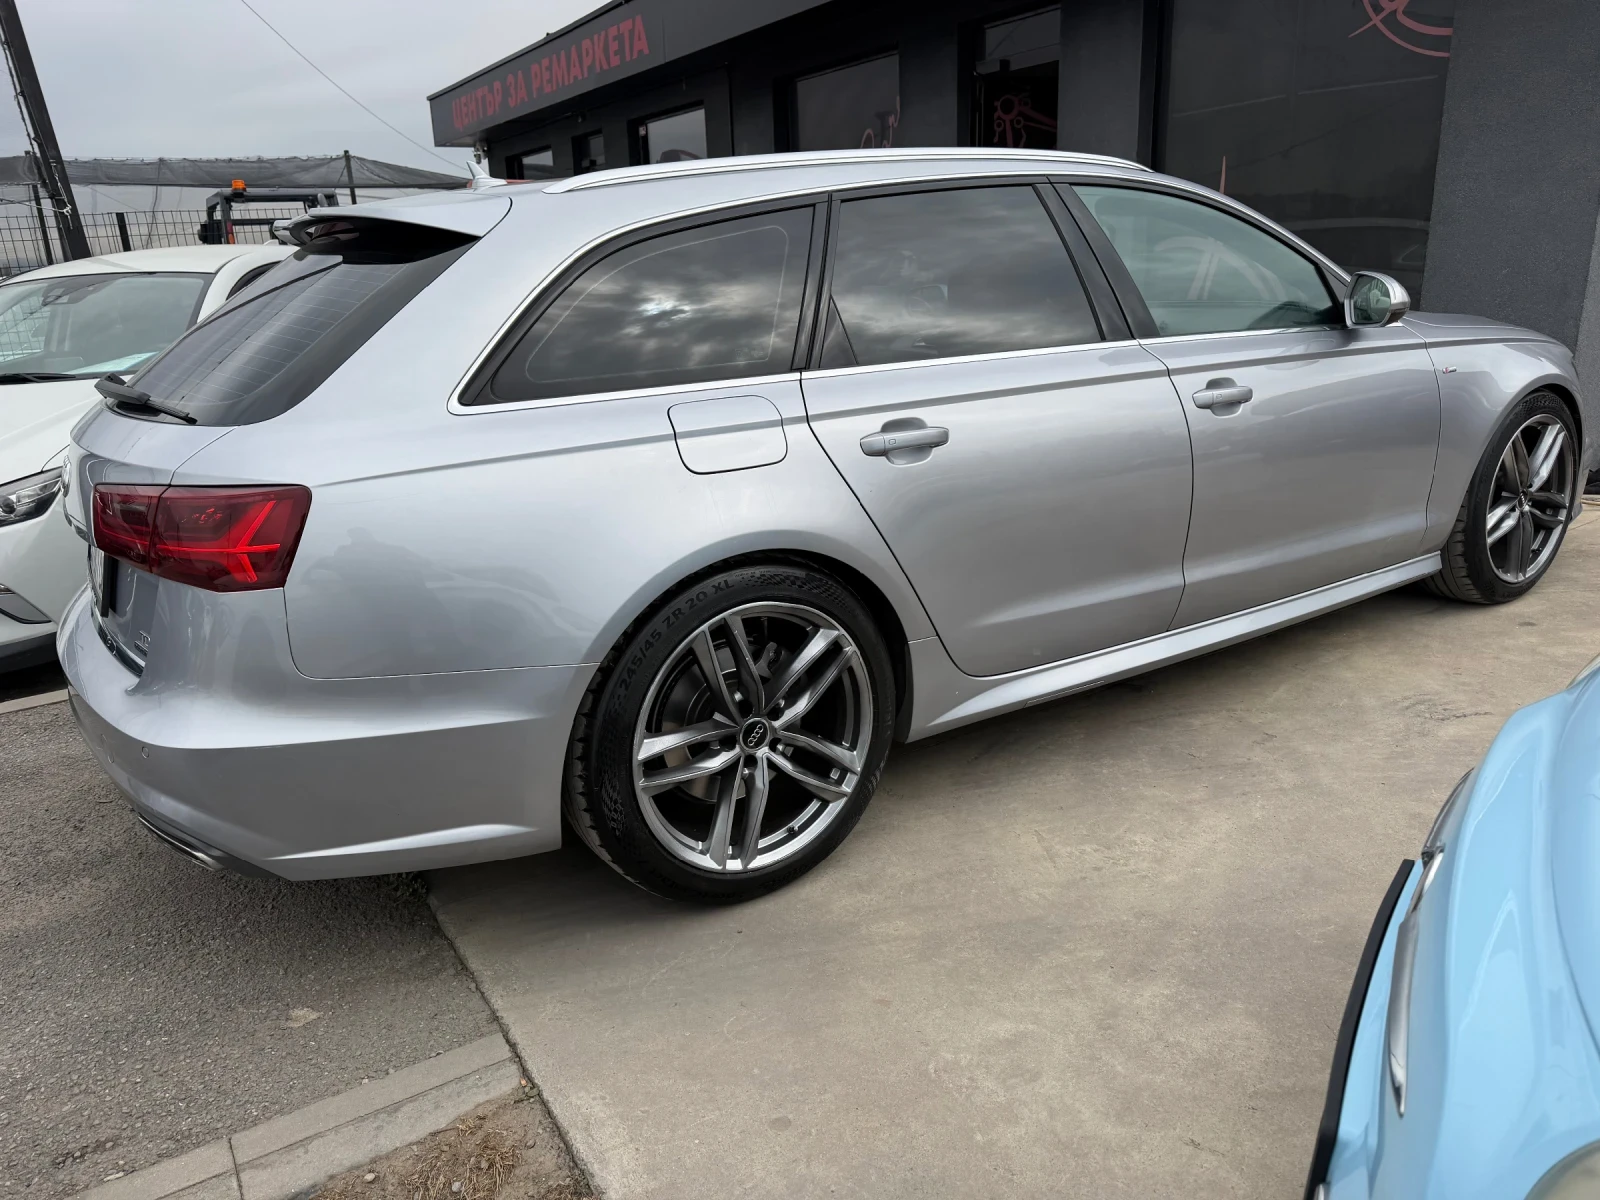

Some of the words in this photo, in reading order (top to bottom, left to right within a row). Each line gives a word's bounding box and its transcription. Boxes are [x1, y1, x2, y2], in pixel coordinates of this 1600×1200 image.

[452, 80, 502, 132] ЦЕНТЪР
[506, 70, 529, 109] ЗА
[530, 14, 650, 98] РЕМАРКЕТА
[619, 628, 663, 692] 245/45
[662, 607, 686, 630] ZR
[685, 590, 708, 611] 20
[711, 578, 735, 596] XL
